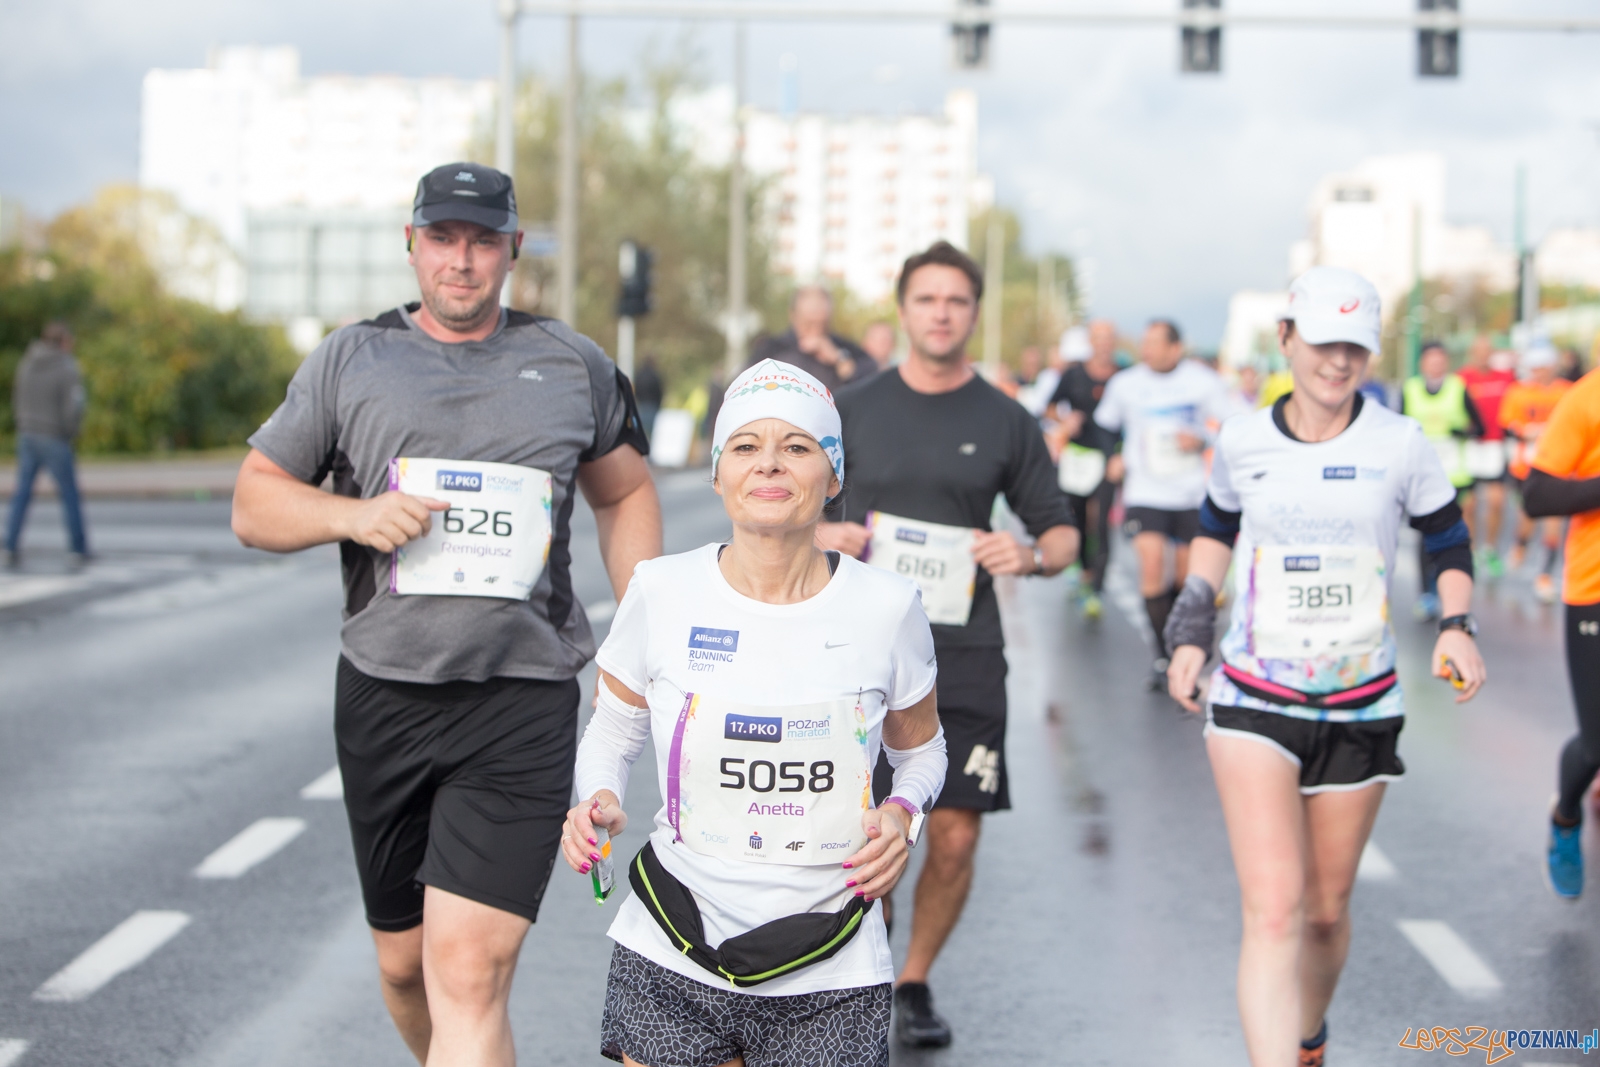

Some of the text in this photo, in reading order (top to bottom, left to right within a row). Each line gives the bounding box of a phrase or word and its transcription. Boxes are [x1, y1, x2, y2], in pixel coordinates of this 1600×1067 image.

[444, 507, 512, 537] 626
[442, 541, 512, 557] Remigiusz
[896, 554, 946, 579] 6161
[1288, 584, 1353, 610] 3851
[694, 633, 722, 645] Allianz
[689, 649, 733, 662] RUNNING
[687, 660, 715, 673] Team
[787, 727, 831, 739] maraton
[719, 757, 835, 793] 5058
[747, 801, 805, 817] Anetta
[785, 840, 806, 852] 4F
